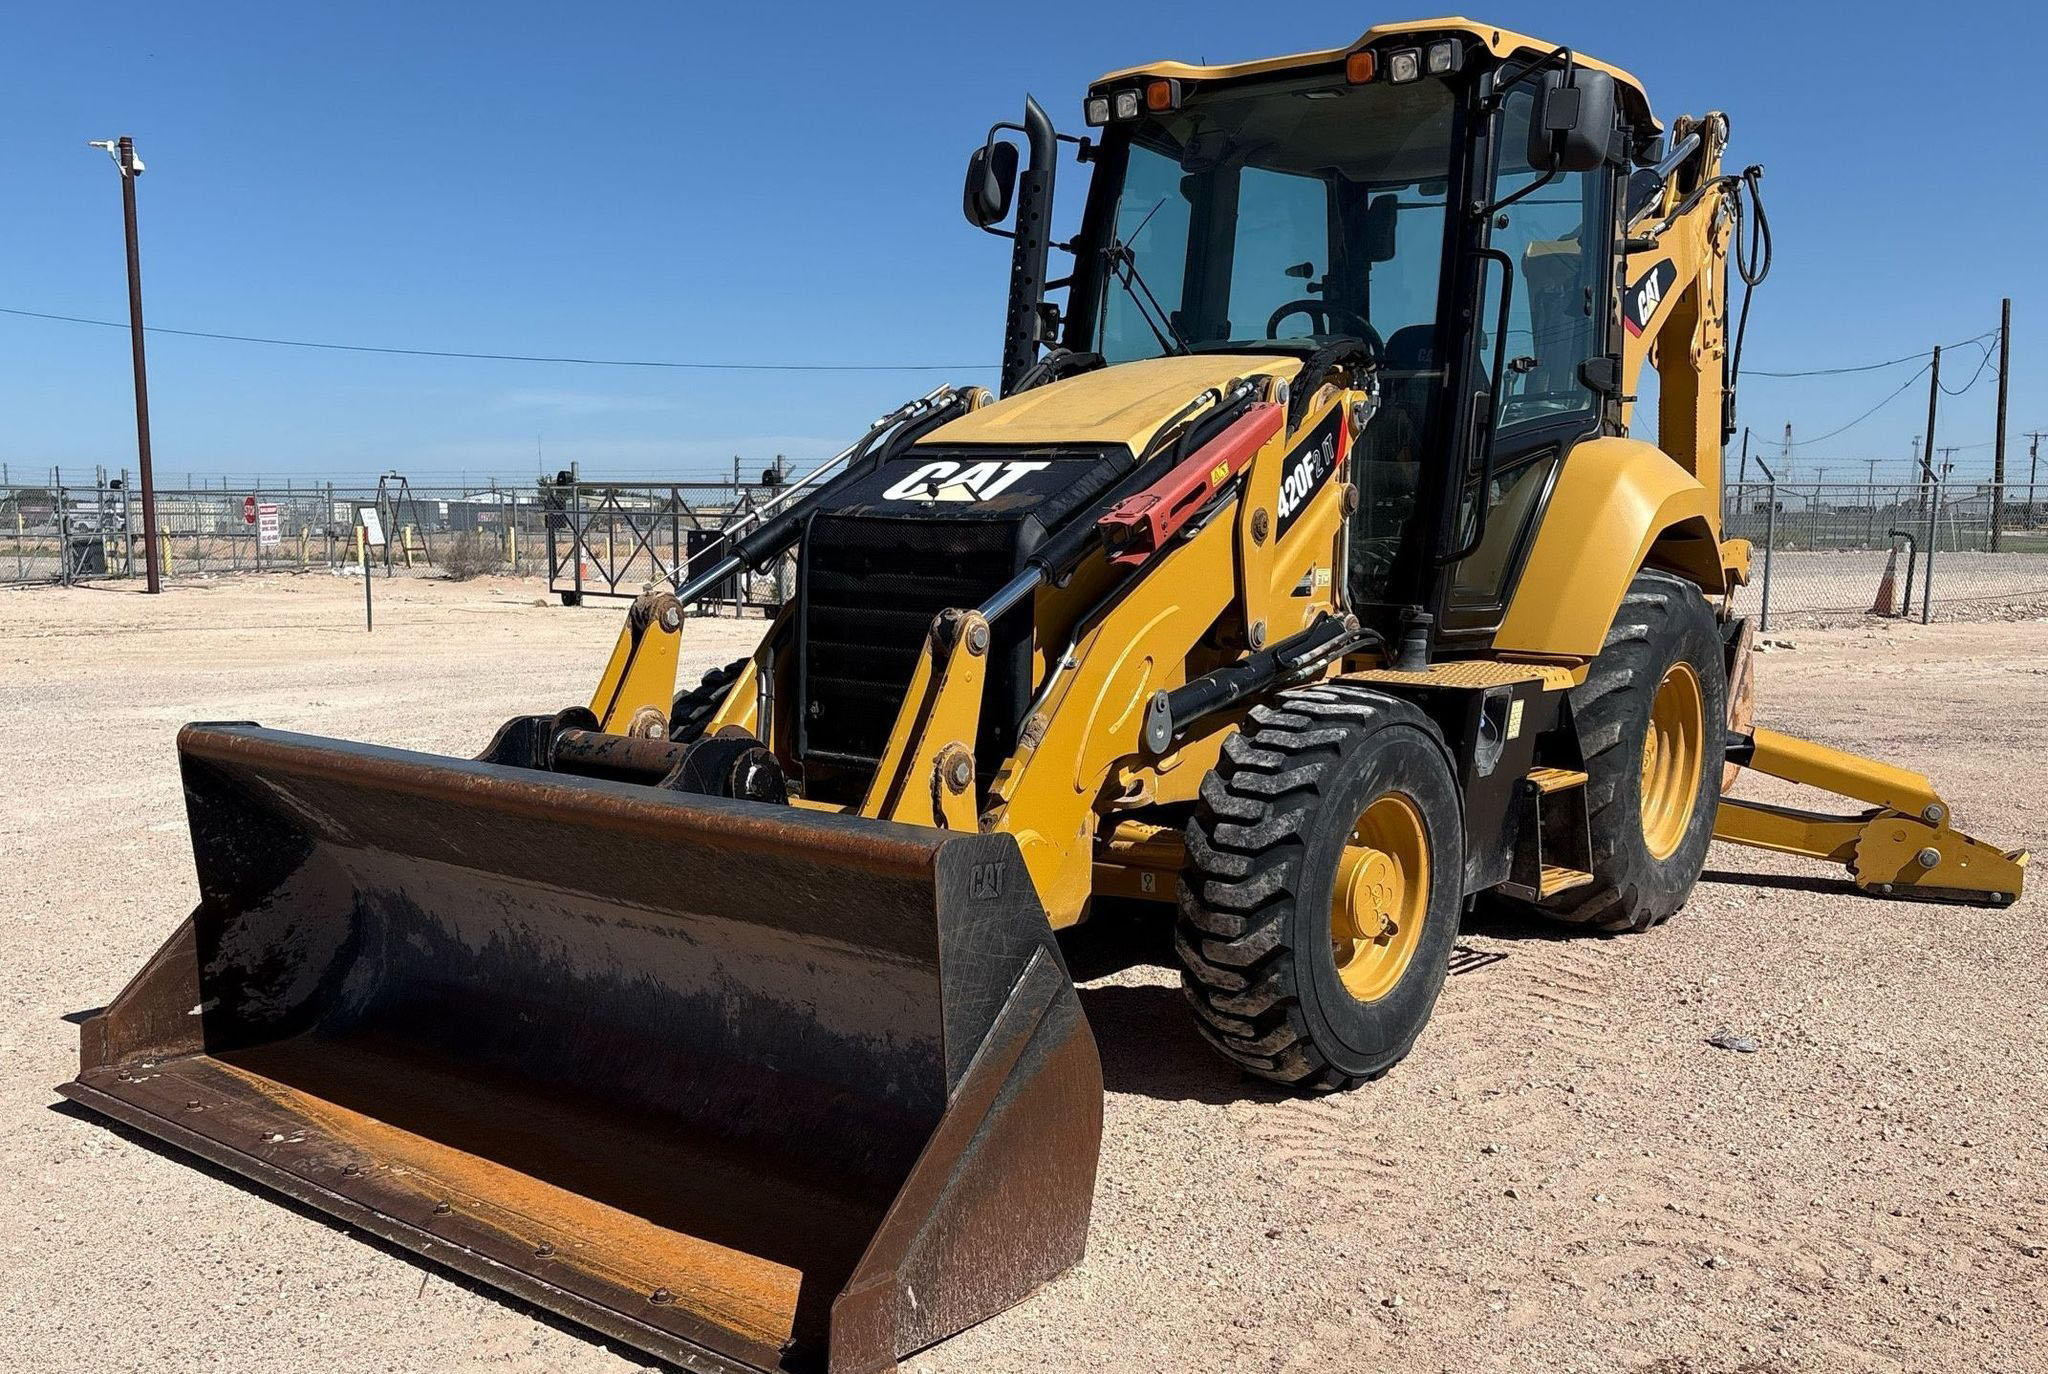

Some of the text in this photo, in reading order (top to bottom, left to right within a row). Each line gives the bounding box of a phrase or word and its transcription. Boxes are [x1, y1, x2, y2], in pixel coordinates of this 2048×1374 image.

[1637, 267, 1660, 326] CAT
[882, 461, 1052, 501] CAT
[970, 862, 1006, 899] CAT
